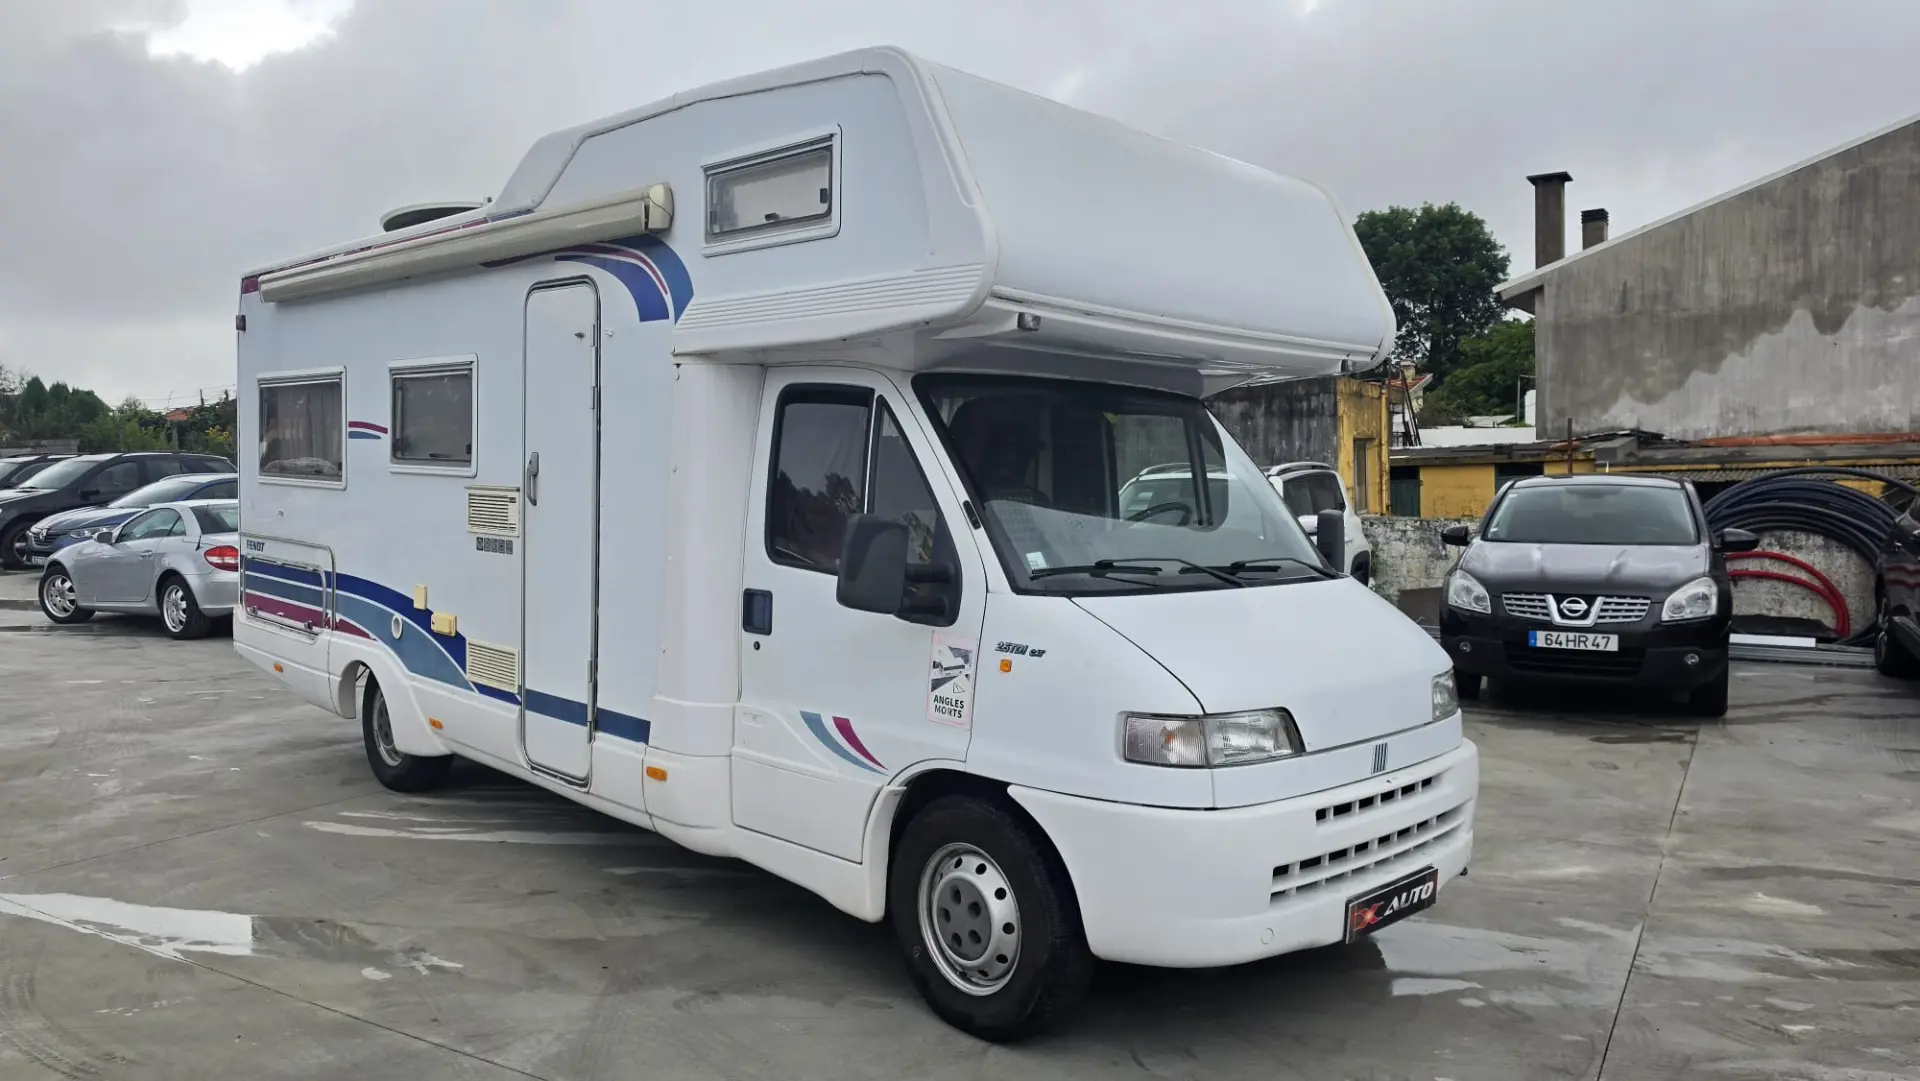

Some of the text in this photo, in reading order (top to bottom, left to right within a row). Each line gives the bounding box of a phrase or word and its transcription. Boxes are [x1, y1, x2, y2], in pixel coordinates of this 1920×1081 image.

[1544, 633, 1611, 650] 64 HR 47
[933, 694, 965, 709] ANGLES
[934, 704, 962, 719] MORTS
[1383, 881, 1434, 916] AUTO
